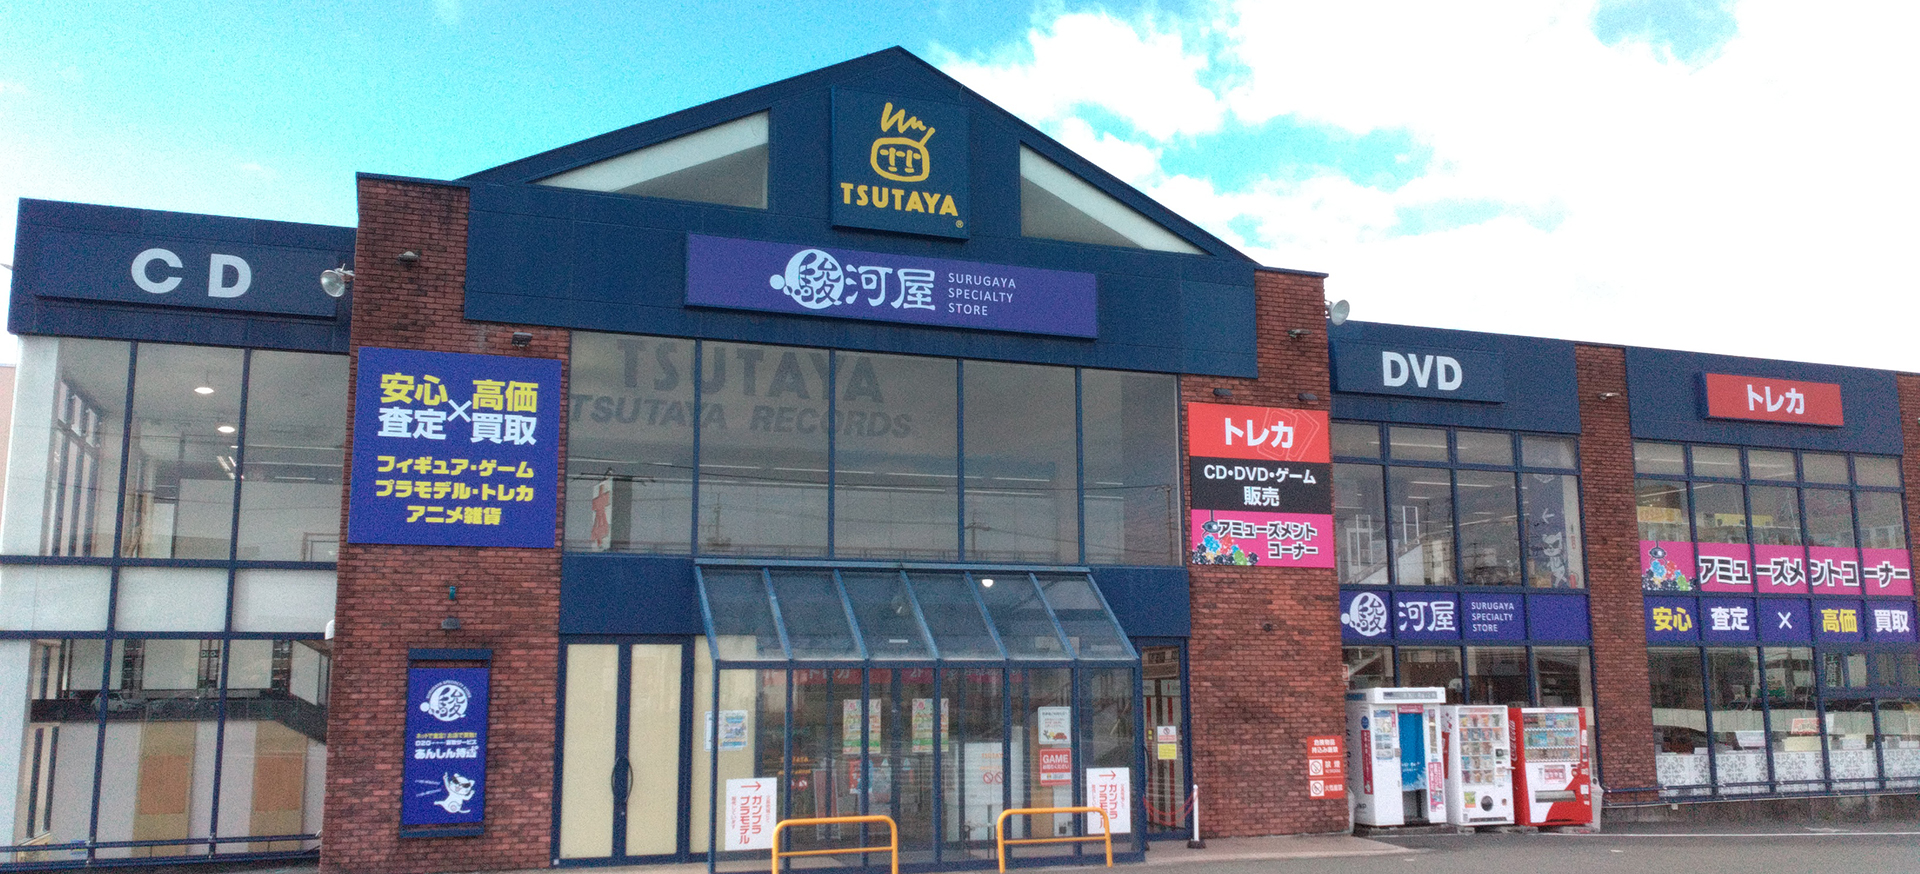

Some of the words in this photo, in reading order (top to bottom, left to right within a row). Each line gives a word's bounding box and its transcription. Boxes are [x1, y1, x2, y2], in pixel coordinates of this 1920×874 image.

[840, 182, 959, 217] TSUTAYA
[130, 248, 253, 298] CD
[769, 248, 936, 311] 駿河屋
[948, 272, 1017, 290] SURUGAYA
[948, 287, 1015, 304] SPECIALTY
[948, 303, 989, 317] STORE
[616, 338, 885, 403] TSUTAYA
[1381, 351, 1464, 392] DVD
[379, 372, 449, 406] 安心
[472, 378, 539, 414] 高価
[1746, 383, 1806, 417] トレカ
[377, 406, 447, 441] 査定
[470, 413, 538, 447] 買取
[569, 393, 727, 430] TSUTAYA
[750, 404, 913, 440] RECORDS
[1225, 417, 1294, 449] トレカ
[1243, 486, 1280, 507] 販売
[406, 505, 502, 527] アニメ雑貨
[1217, 519, 1318, 541] アミューズメント
[1268, 540, 1319, 560] コーナー
[1340, 592, 1456, 637] 駿河屋
[1471, 601, 1515, 611] SURUGAYA
[1471, 612, 1513, 622] SPECIALTY
[1652, 606, 1693, 632] 安心
[1710, 606, 1750, 631] 査定
[1820, 608, 1858, 633] 高価
[1874, 609, 1910, 633] 買取
[1472, 623, 1499, 633] STORE
[1042, 754, 1069, 764] GAME
[752, 795, 762, 834] ガンプラ
[1109, 783, 1118, 819] ガンプラ
